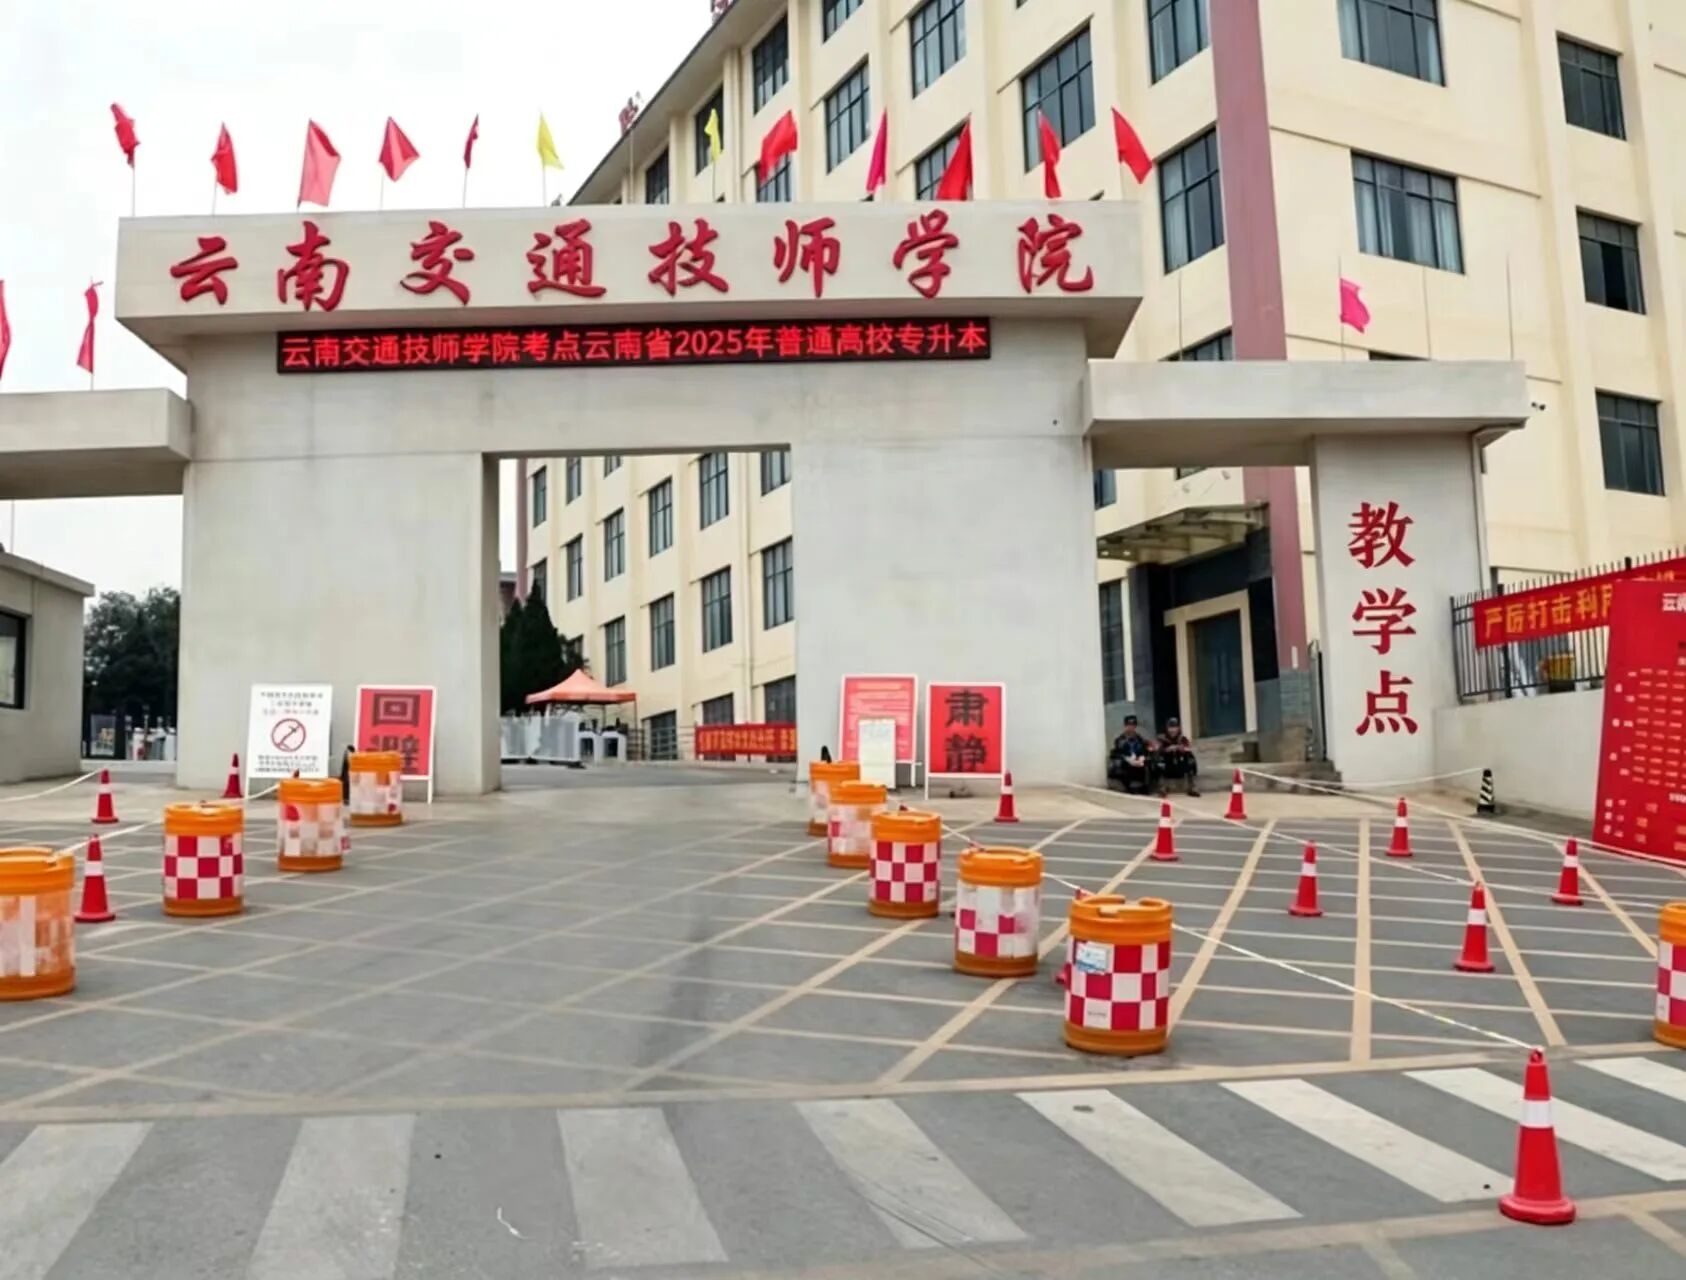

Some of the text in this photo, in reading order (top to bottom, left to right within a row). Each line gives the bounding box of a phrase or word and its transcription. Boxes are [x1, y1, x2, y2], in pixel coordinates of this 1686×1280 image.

[170, 208, 1094, 312] 云南交通技师学院
[282, 321, 987, 367] 云南交通技师学院考点云南省2025年普通高校专升本
[1348, 501, 1419, 737] 教学点
[945, 688, 988, 772] 肃静
